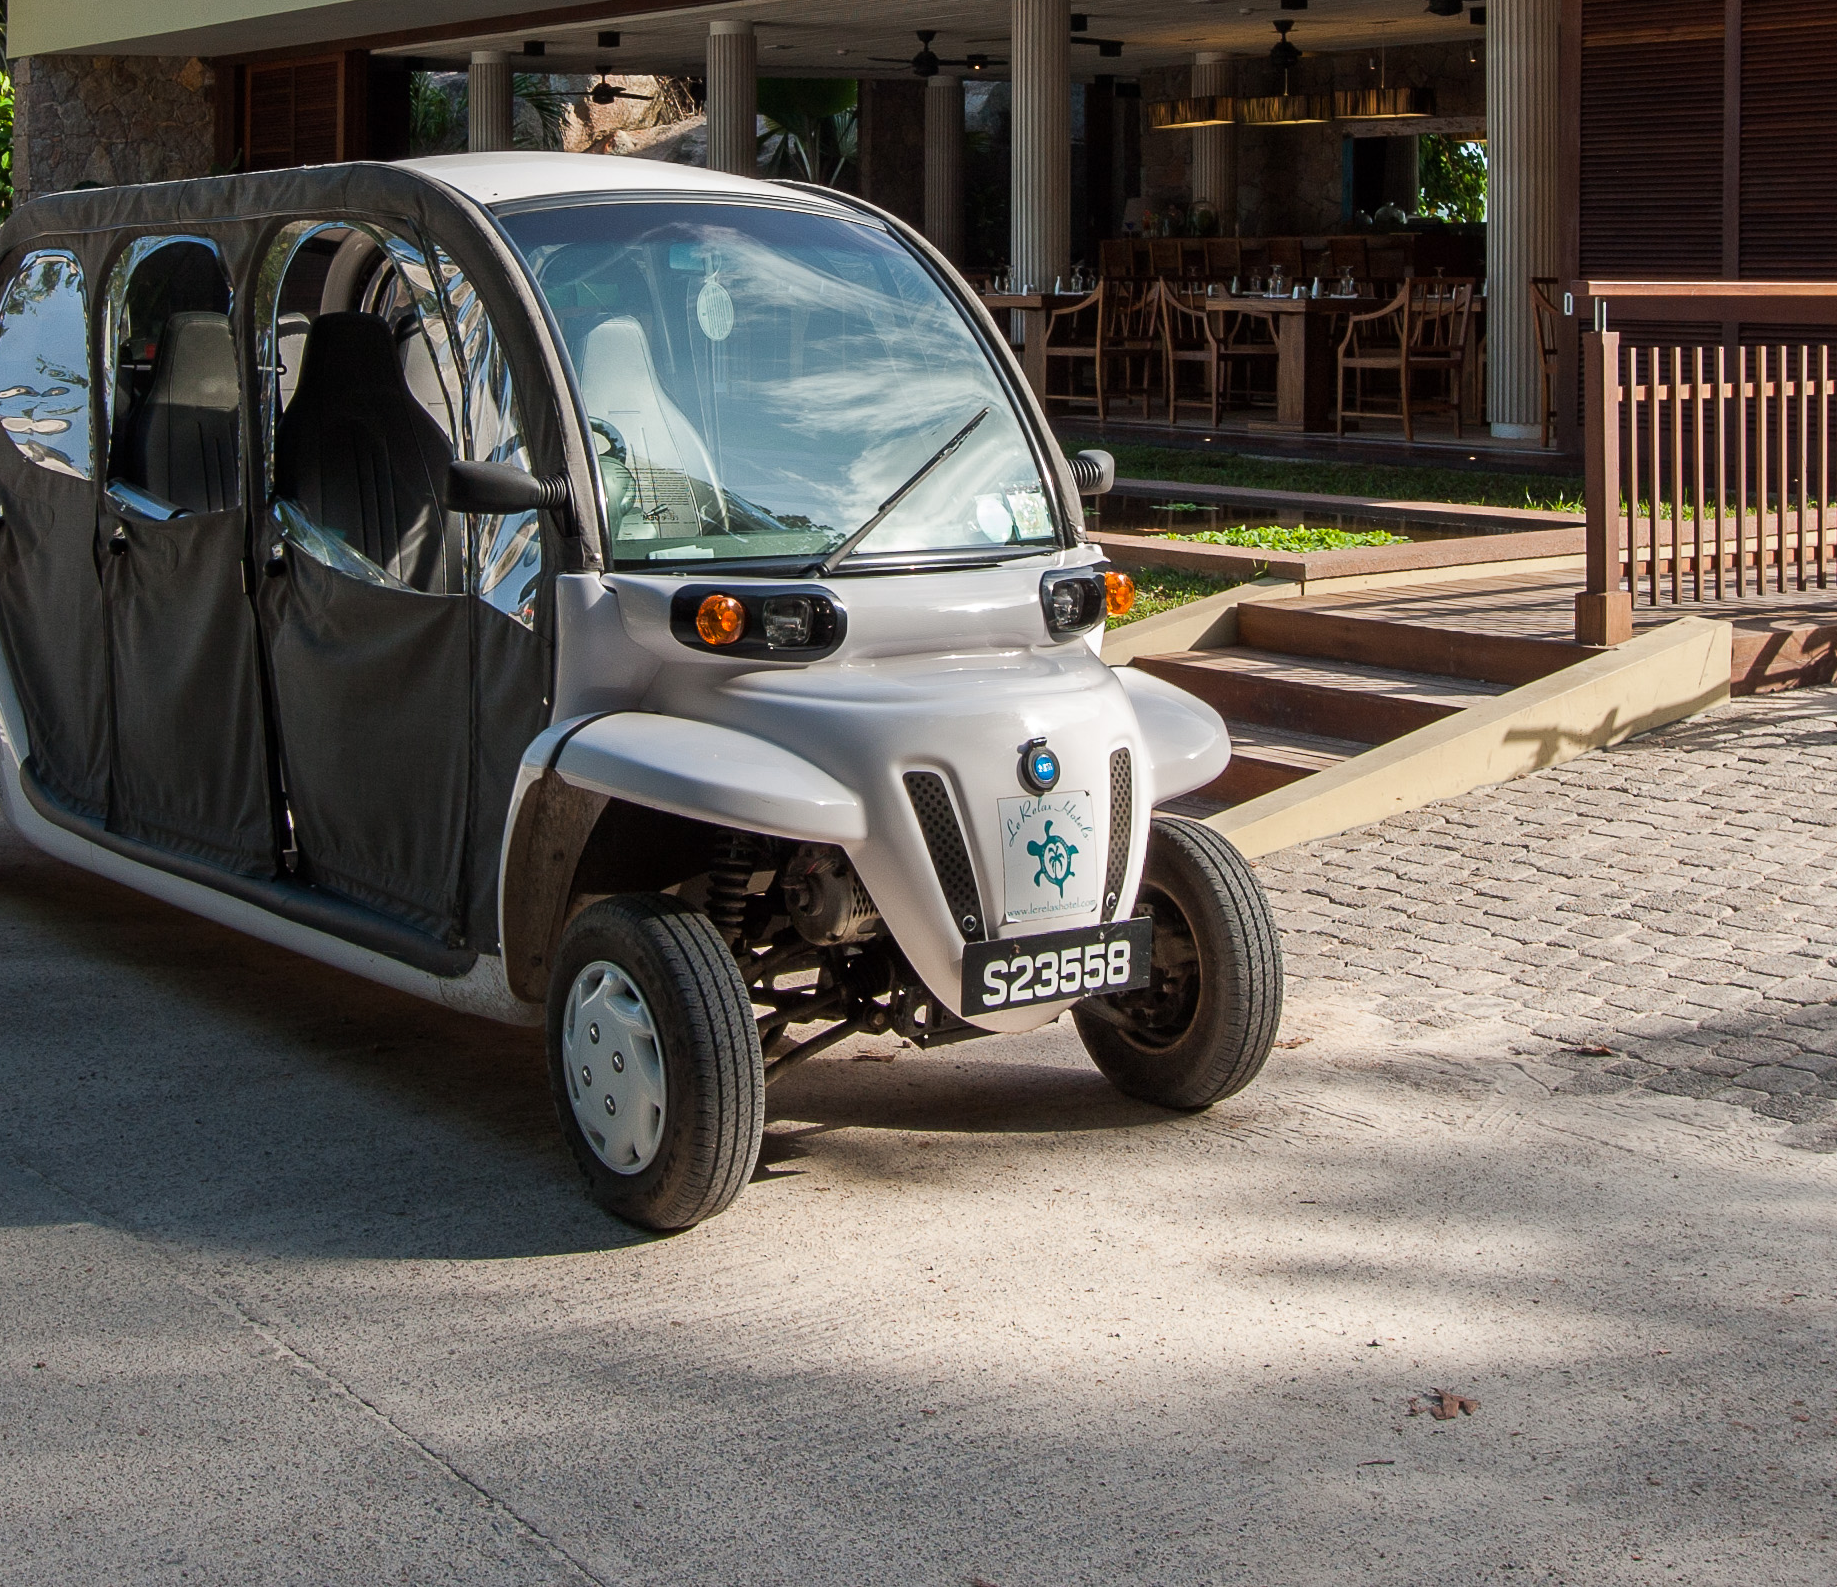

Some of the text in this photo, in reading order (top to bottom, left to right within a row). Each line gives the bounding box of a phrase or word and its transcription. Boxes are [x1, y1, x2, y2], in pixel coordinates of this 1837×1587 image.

[1006, 818, 1021, 848] Le
[1019, 797, 1052, 823] Relax
[1007, 896, 1096, 917] www.lerelaxhotel.com
[982, 939, 1131, 1007] S23558
